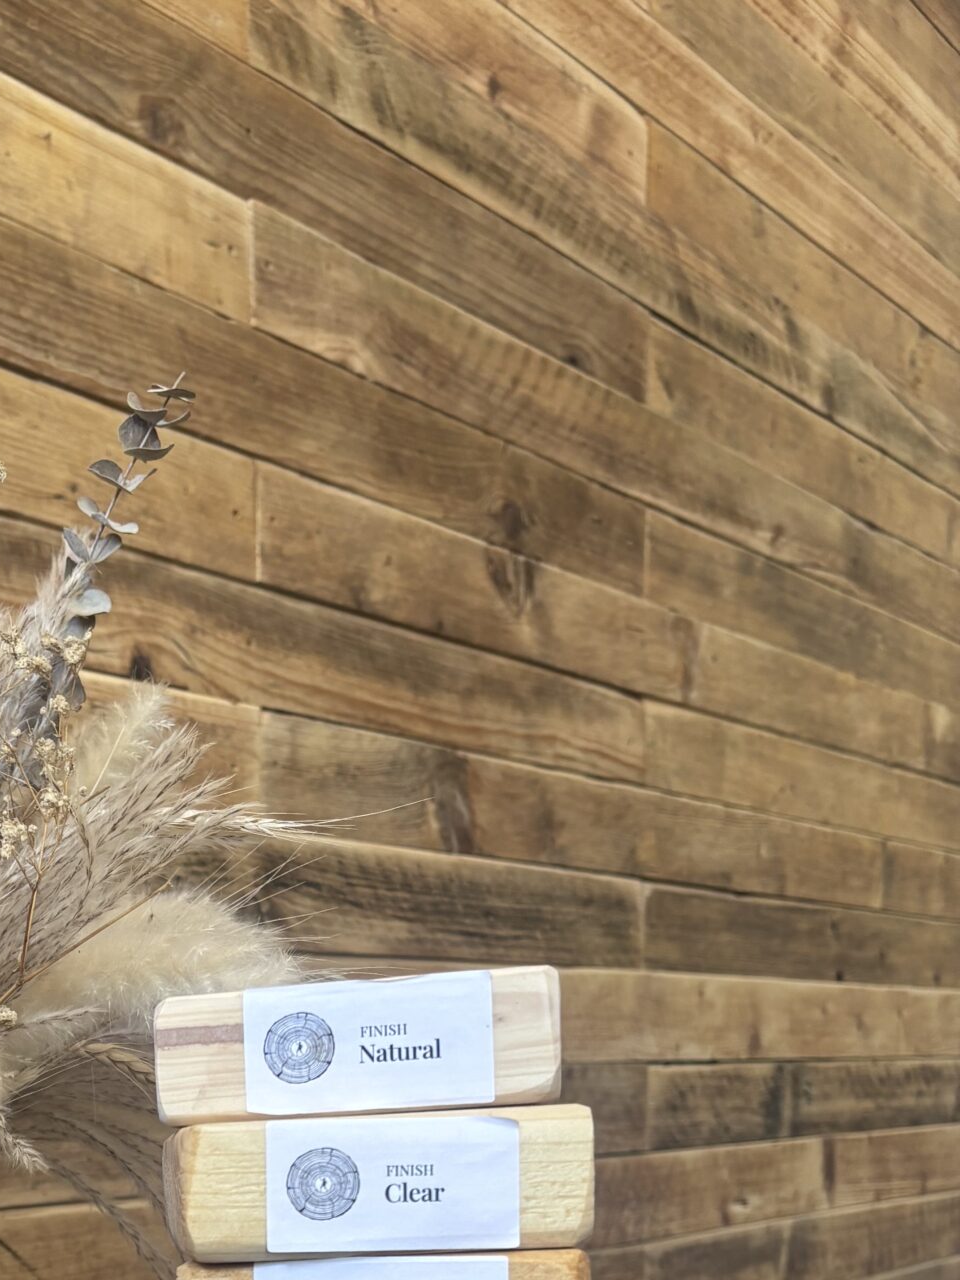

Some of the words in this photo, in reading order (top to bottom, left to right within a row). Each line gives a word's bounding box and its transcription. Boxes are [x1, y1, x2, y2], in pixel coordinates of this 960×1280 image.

[359, 1023, 408, 1038] FINISH
[358, 1038, 442, 1064] Natural
[385, 1164, 435, 1178] FINISH
[384, 1182, 446, 1204] Clear
